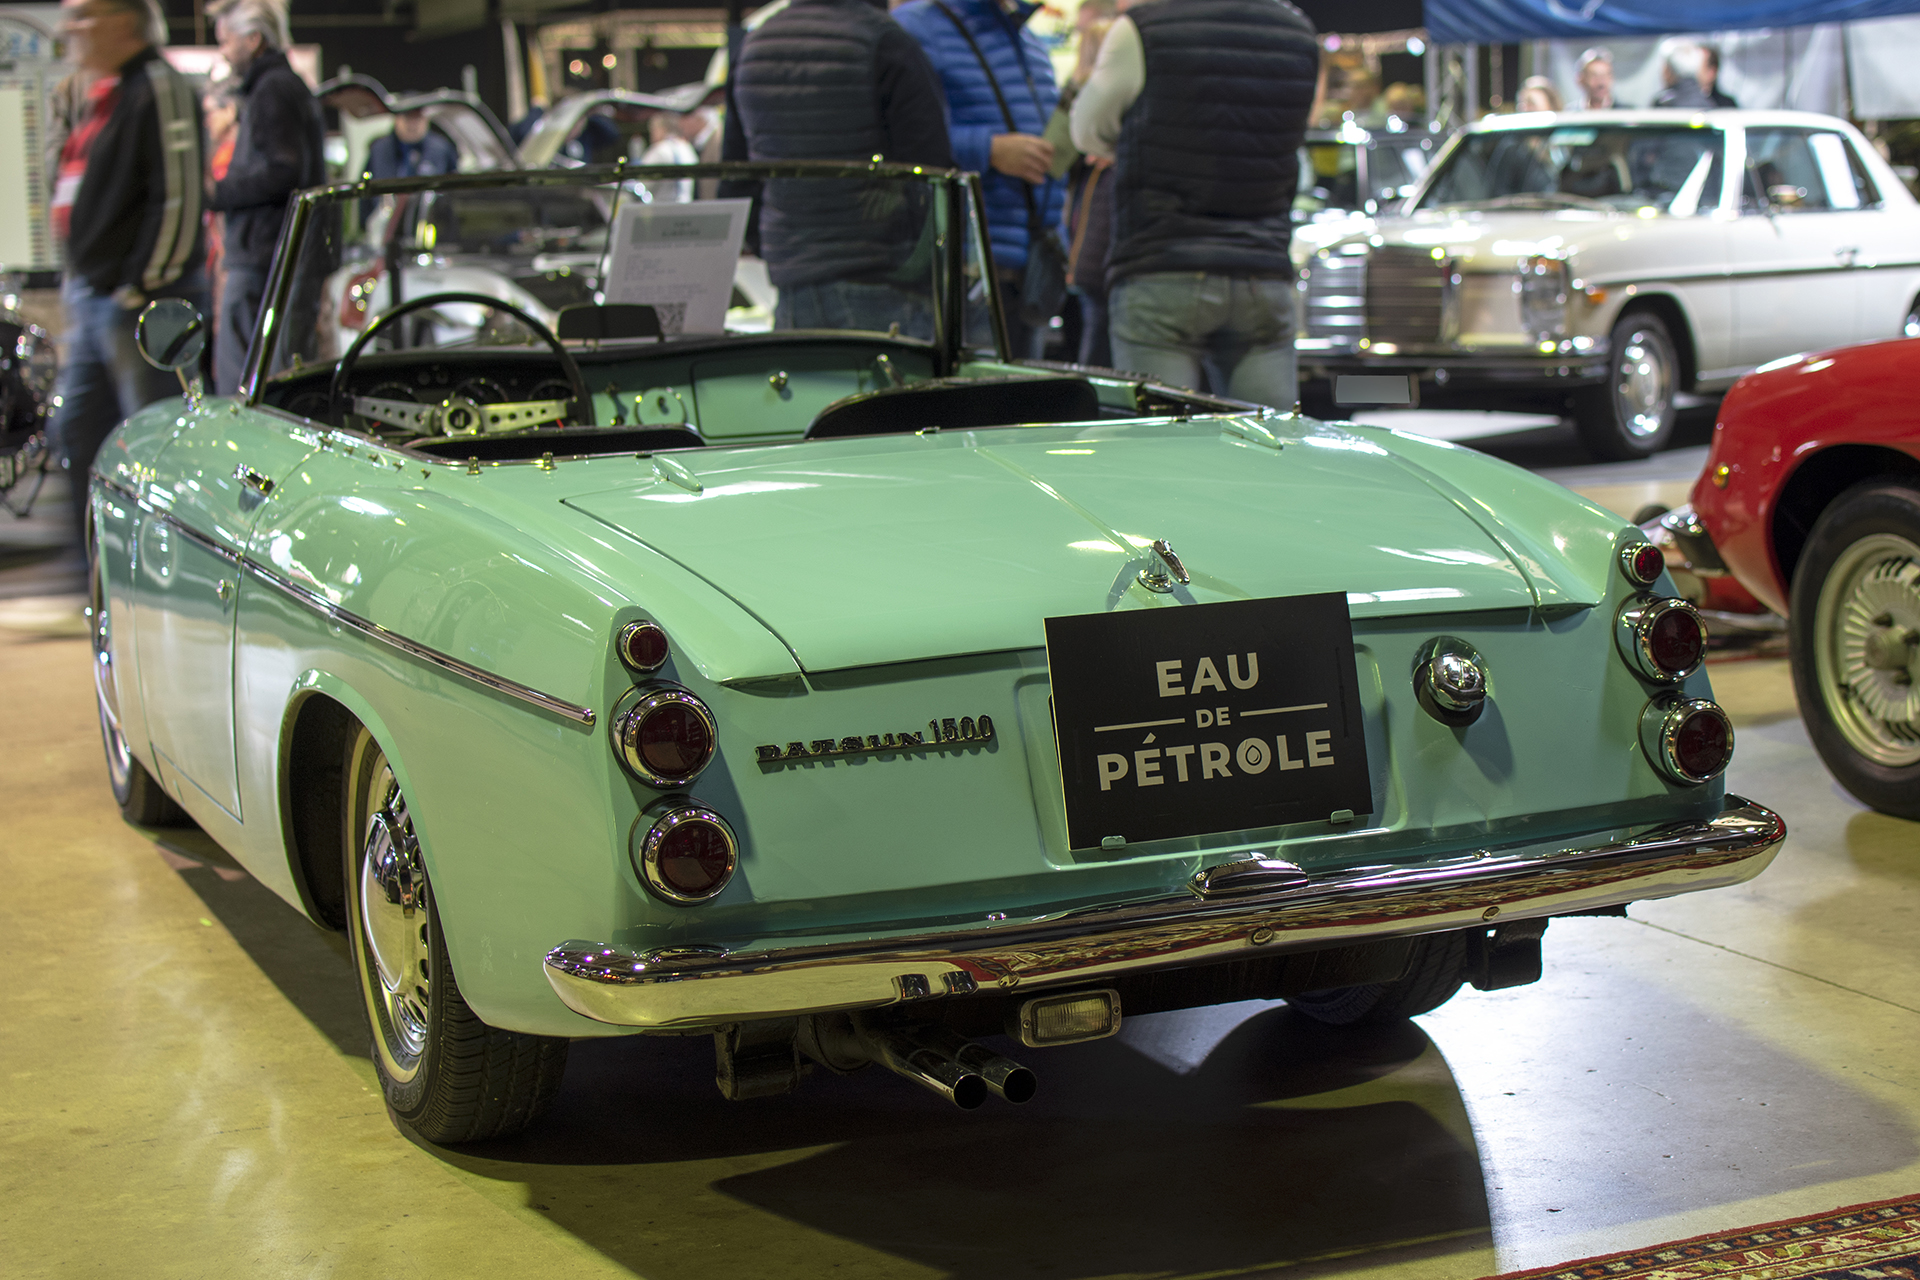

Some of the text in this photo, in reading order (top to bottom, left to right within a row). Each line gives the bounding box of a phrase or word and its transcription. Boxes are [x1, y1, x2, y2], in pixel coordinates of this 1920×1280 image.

[1156, 652, 1259, 697] EAU
[755, 714, 996, 761] DATSUN 1500
[1195, 706, 1231, 729] DE
[1097, 730, 1335, 791] PÉTROLE
